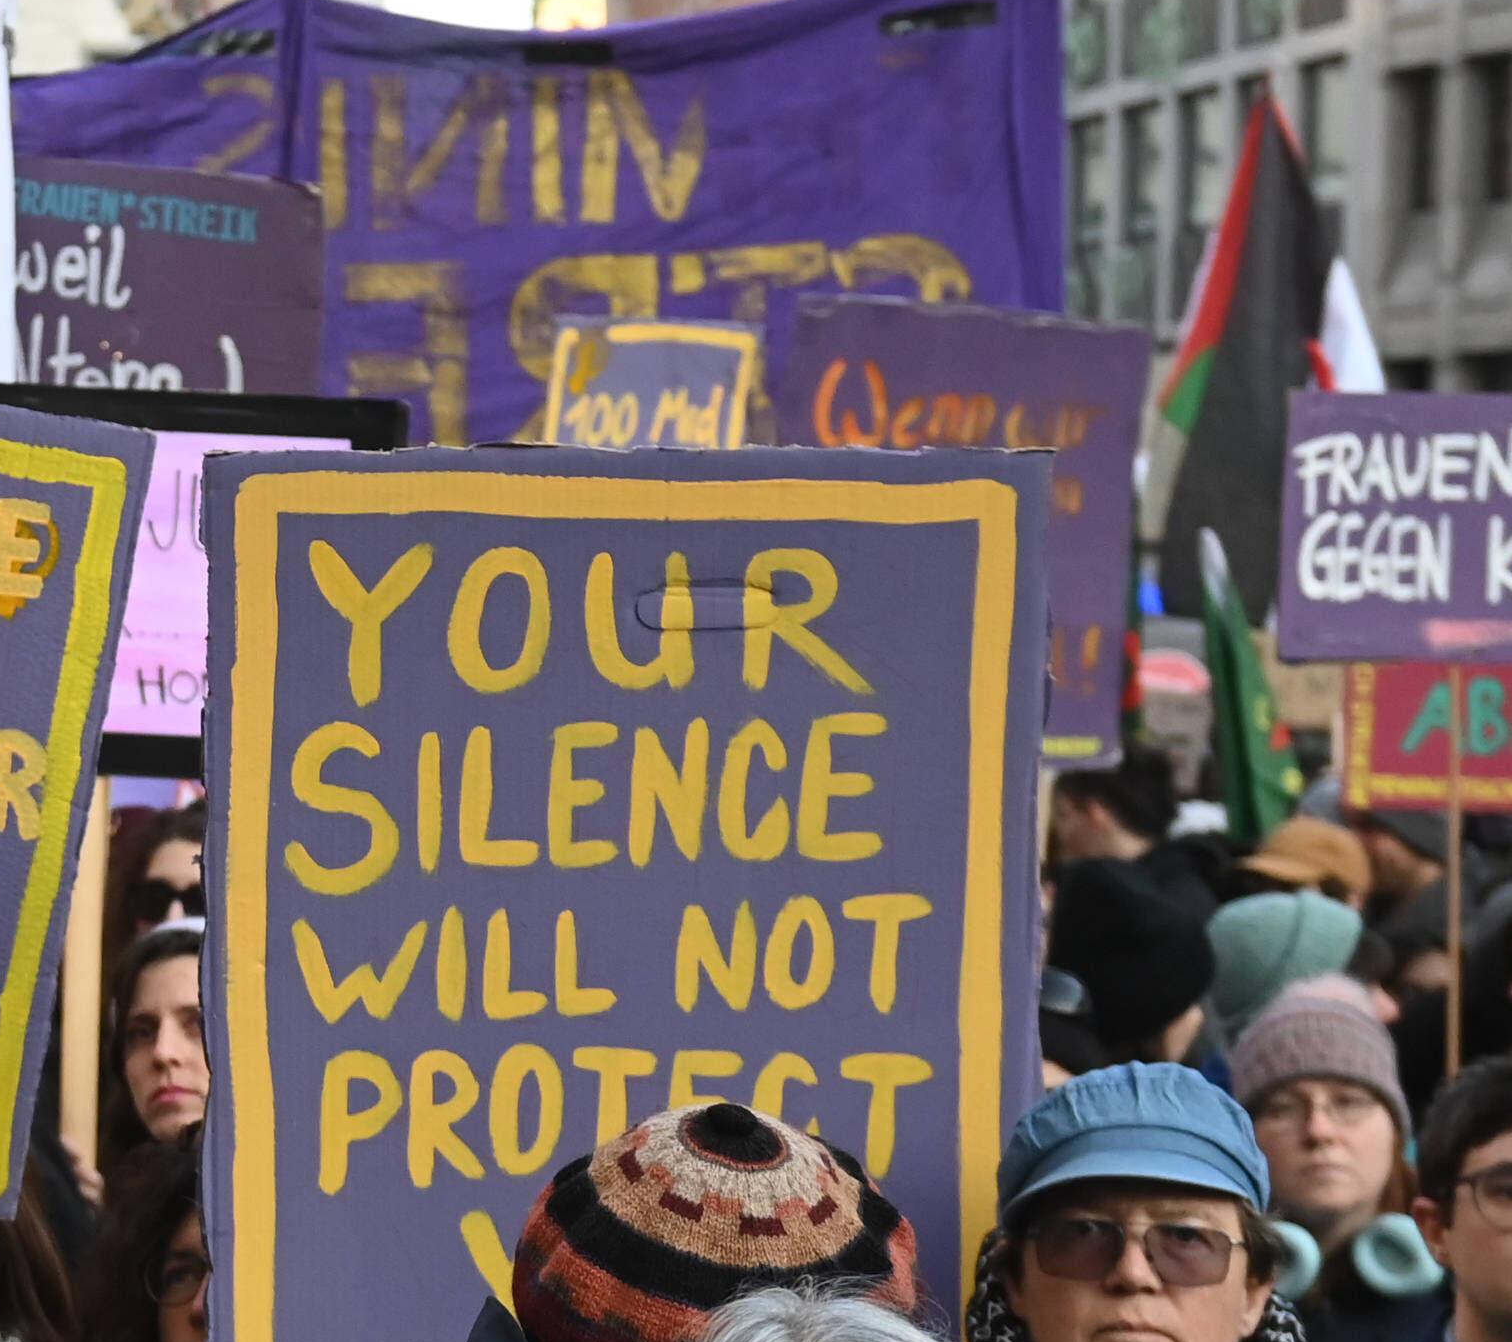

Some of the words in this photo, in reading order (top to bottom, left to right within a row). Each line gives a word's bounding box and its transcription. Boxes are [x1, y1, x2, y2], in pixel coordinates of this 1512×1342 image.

[814, 358, 995, 449] Wenn
[1298, 509, 1451, 603] GEGEN
[307, 539, 874, 707] YOUR
[284, 711, 889, 896] SILENCE
[291, 904, 617, 1023] WILL
[674, 892, 933, 1014] NOT
